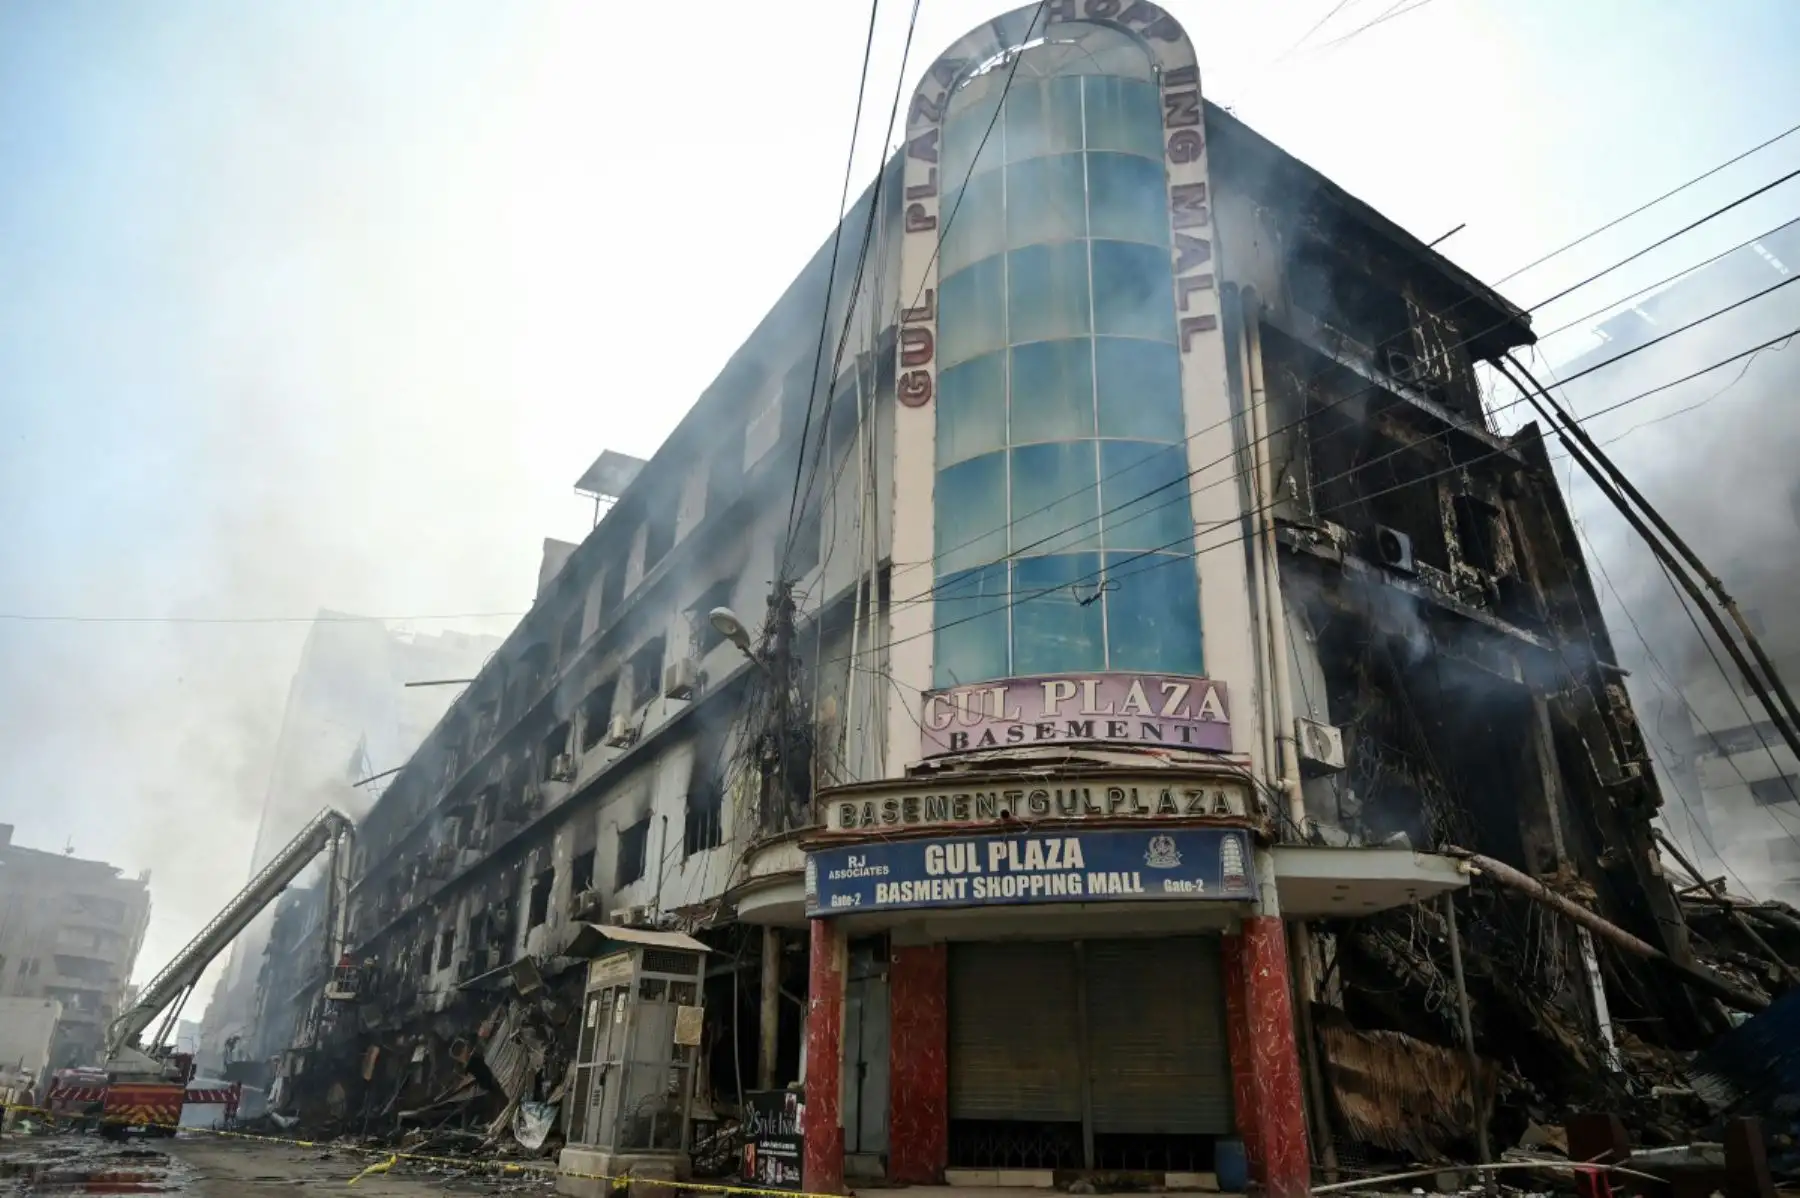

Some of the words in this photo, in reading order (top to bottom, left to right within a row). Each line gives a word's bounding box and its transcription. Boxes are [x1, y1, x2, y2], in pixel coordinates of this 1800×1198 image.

[905, 57, 970, 233] PLAZA
[1170, 181, 1217, 354] MALL
[899, 289, 934, 408] GUL
[923, 686, 1021, 730] GUL
[1040, 679, 1231, 722] PLAZA
[949, 719, 1199, 750] BASEMENT
[828, 865, 890, 880] ASSOCIATES
[848, 856, 866, 868] RJ
[924, 842, 982, 876] GUL
[988, 838, 1085, 873] PLAZA
[831, 893, 862, 908] Gate-2
[875, 878, 968, 904] BASMENT
[973, 873, 1084, 899] SHOPPING
[1088, 872, 1145, 895] MALL
[1163, 878, 1205, 893] Gate-2
